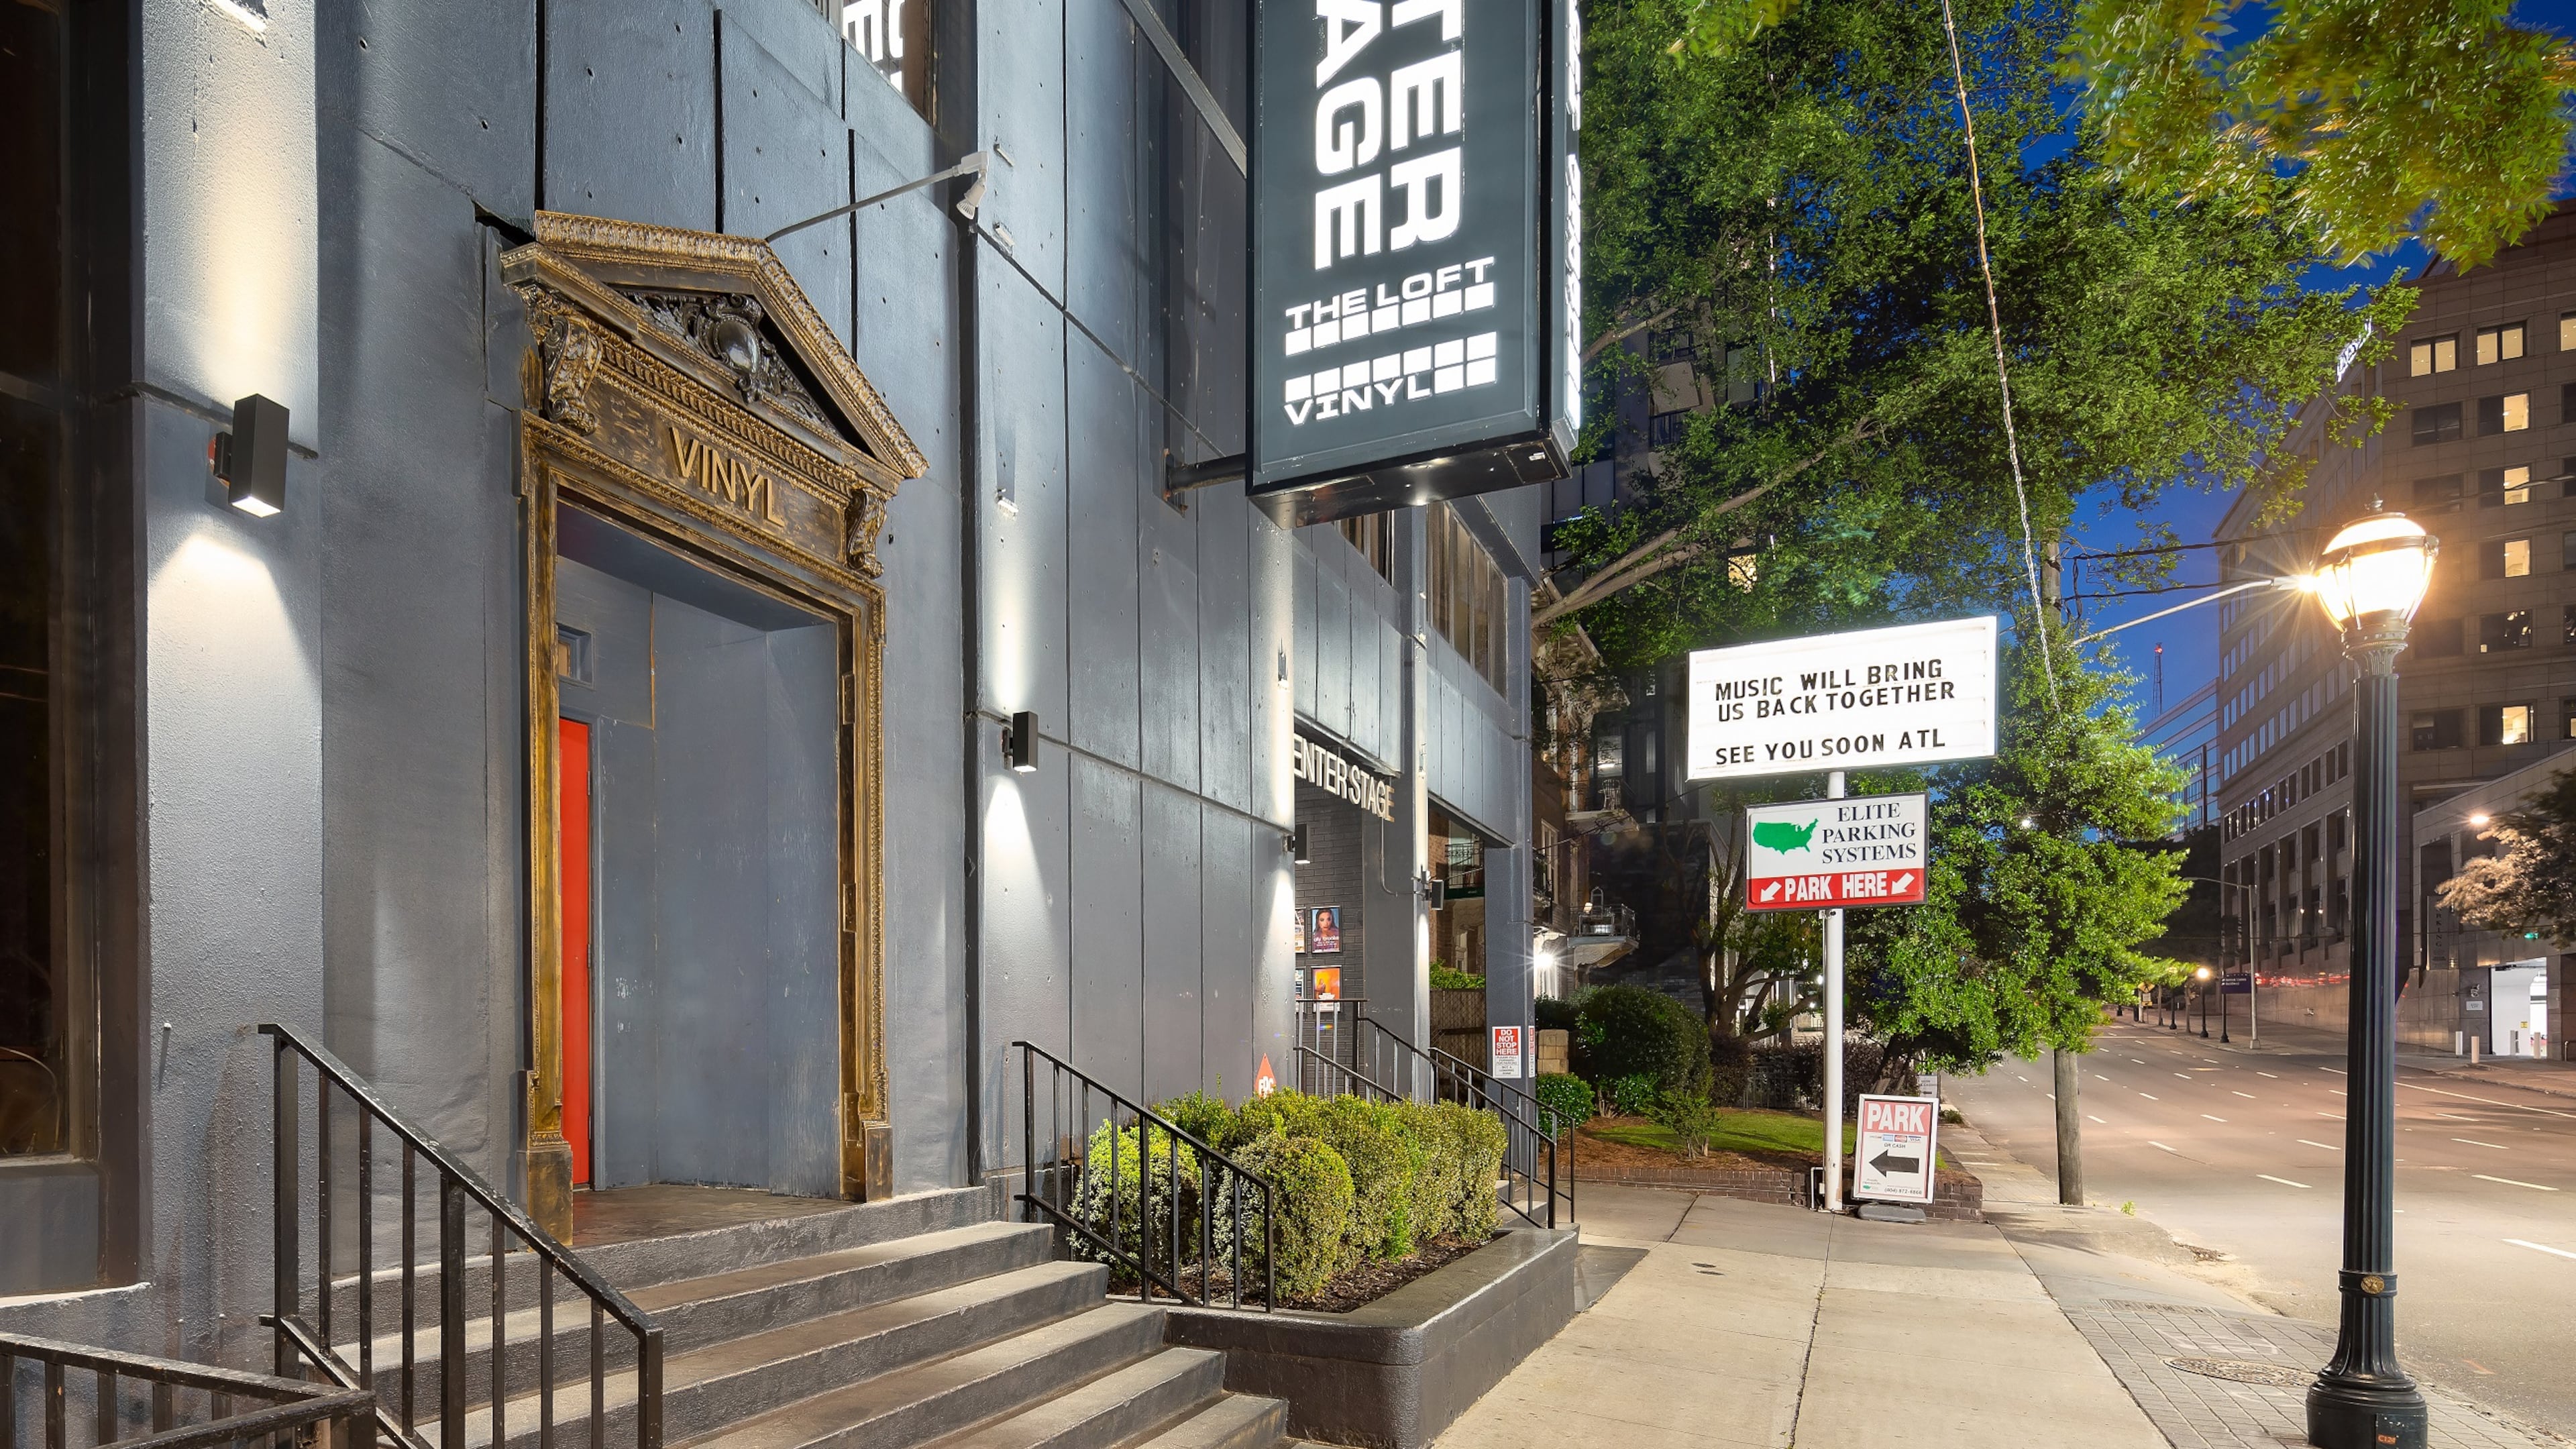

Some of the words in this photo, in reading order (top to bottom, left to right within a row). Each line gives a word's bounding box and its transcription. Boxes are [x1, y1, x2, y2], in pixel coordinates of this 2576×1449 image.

[1315, 0, 1382, 271] AGE
[1285, 288, 1367, 330] THE
[1376, 256, 1495, 307] LOFT
[1283, 374, 1432, 427] VINYL
[670, 427, 786, 528] VINYL
[1715, 676, 1783, 701] MUSIC
[1801, 669, 1856, 691] WILL
[1868, 659, 1942, 685] BRING
[1718, 703, 1743, 722] US
[1757, 694, 1817, 718] BACK
[1826, 681, 1955, 710] TOGETHER
[1716, 745, 1754, 765] SEE
[1766, 739, 1812, 761] YOU
[1821, 734, 1884, 756] SOON
[1898, 729, 1945, 749] ATL
[1348, 764, 1395, 823] STAGE
[1838, 802, 1900, 822] ELITE
[1822, 822, 1916, 844] PARKING
[1822, 843, 1917, 864] SYSTEMS
[1784, 875, 1833, 902] PARK
[1842, 872, 1887, 899] HERE
[1867, 1102, 1925, 1133] PARK
